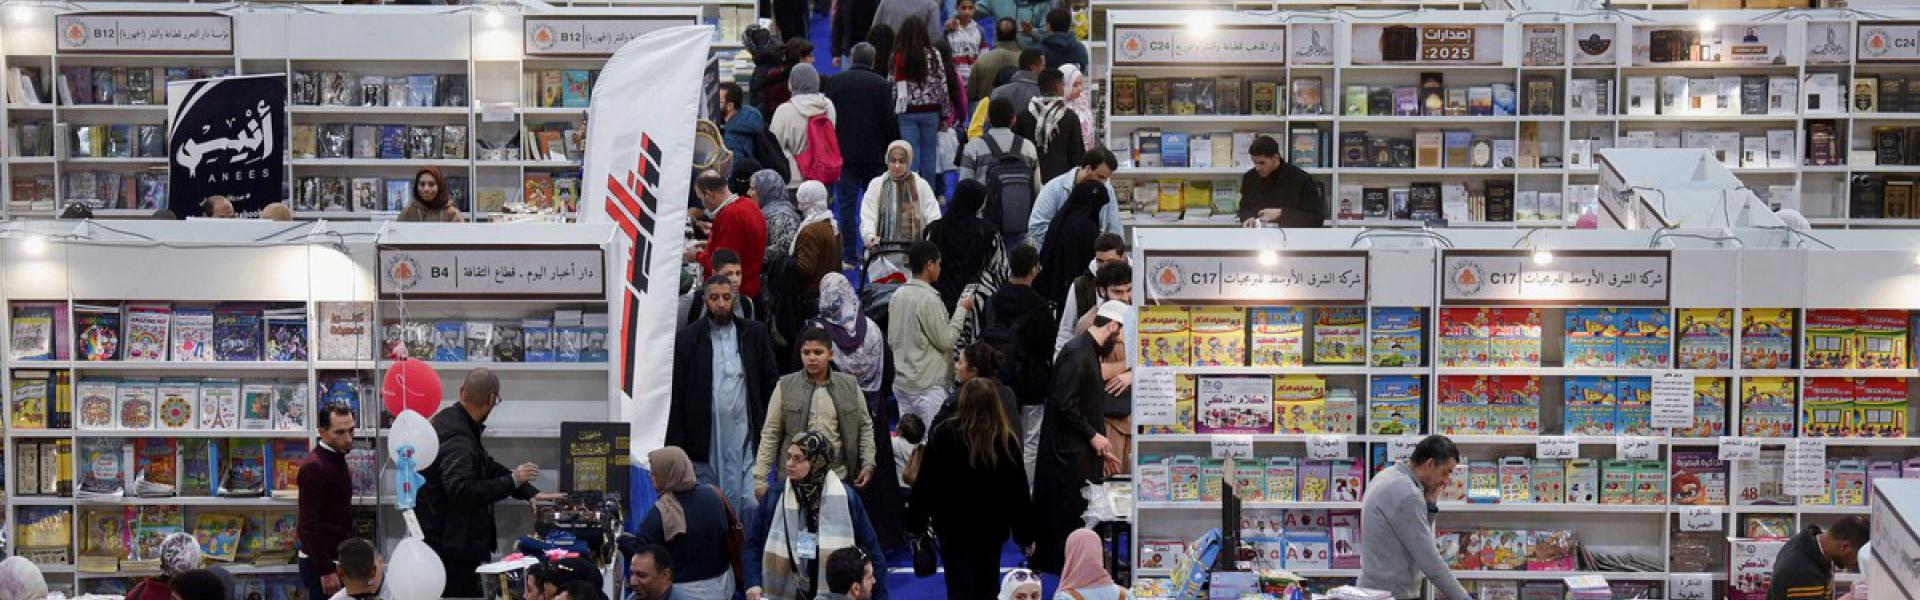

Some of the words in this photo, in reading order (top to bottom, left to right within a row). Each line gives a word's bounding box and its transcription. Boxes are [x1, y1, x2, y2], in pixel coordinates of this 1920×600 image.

[94, 29, 115, 39] B12
[561, 32, 582, 42] B12
[1425, 28, 1471, 43] إصدارات
[1150, 41, 1170, 51] C24
[1895, 39, 1915, 48] C24
[208, 168, 270, 184] ANEES
[431, 265, 449, 278] B4
[463, 266, 490, 277] الثقافة
[495, 266, 516, 284] قطاع
[527, 267, 547, 283] اليوم
[550, 262, 575, 281] أخبار
[578, 267, 593, 281] دار
[1191, 272, 1217, 285] C17
[1269, 269, 1303, 286] الأوسط
[1338, 269, 1361, 288] شركة
[1490, 272, 1517, 285] C17
[1568, 269, 1604, 287] الأوسط
[1639, 269, 1663, 288] شركة
[1307, 272, 1335, 288] الشرق
[1607, 272, 1637, 288] الشرق
[1204, 394, 1235, 407] الذكي
[1238, 394, 1269, 405] الكلام
[1742, 486, 1758, 500] 48
